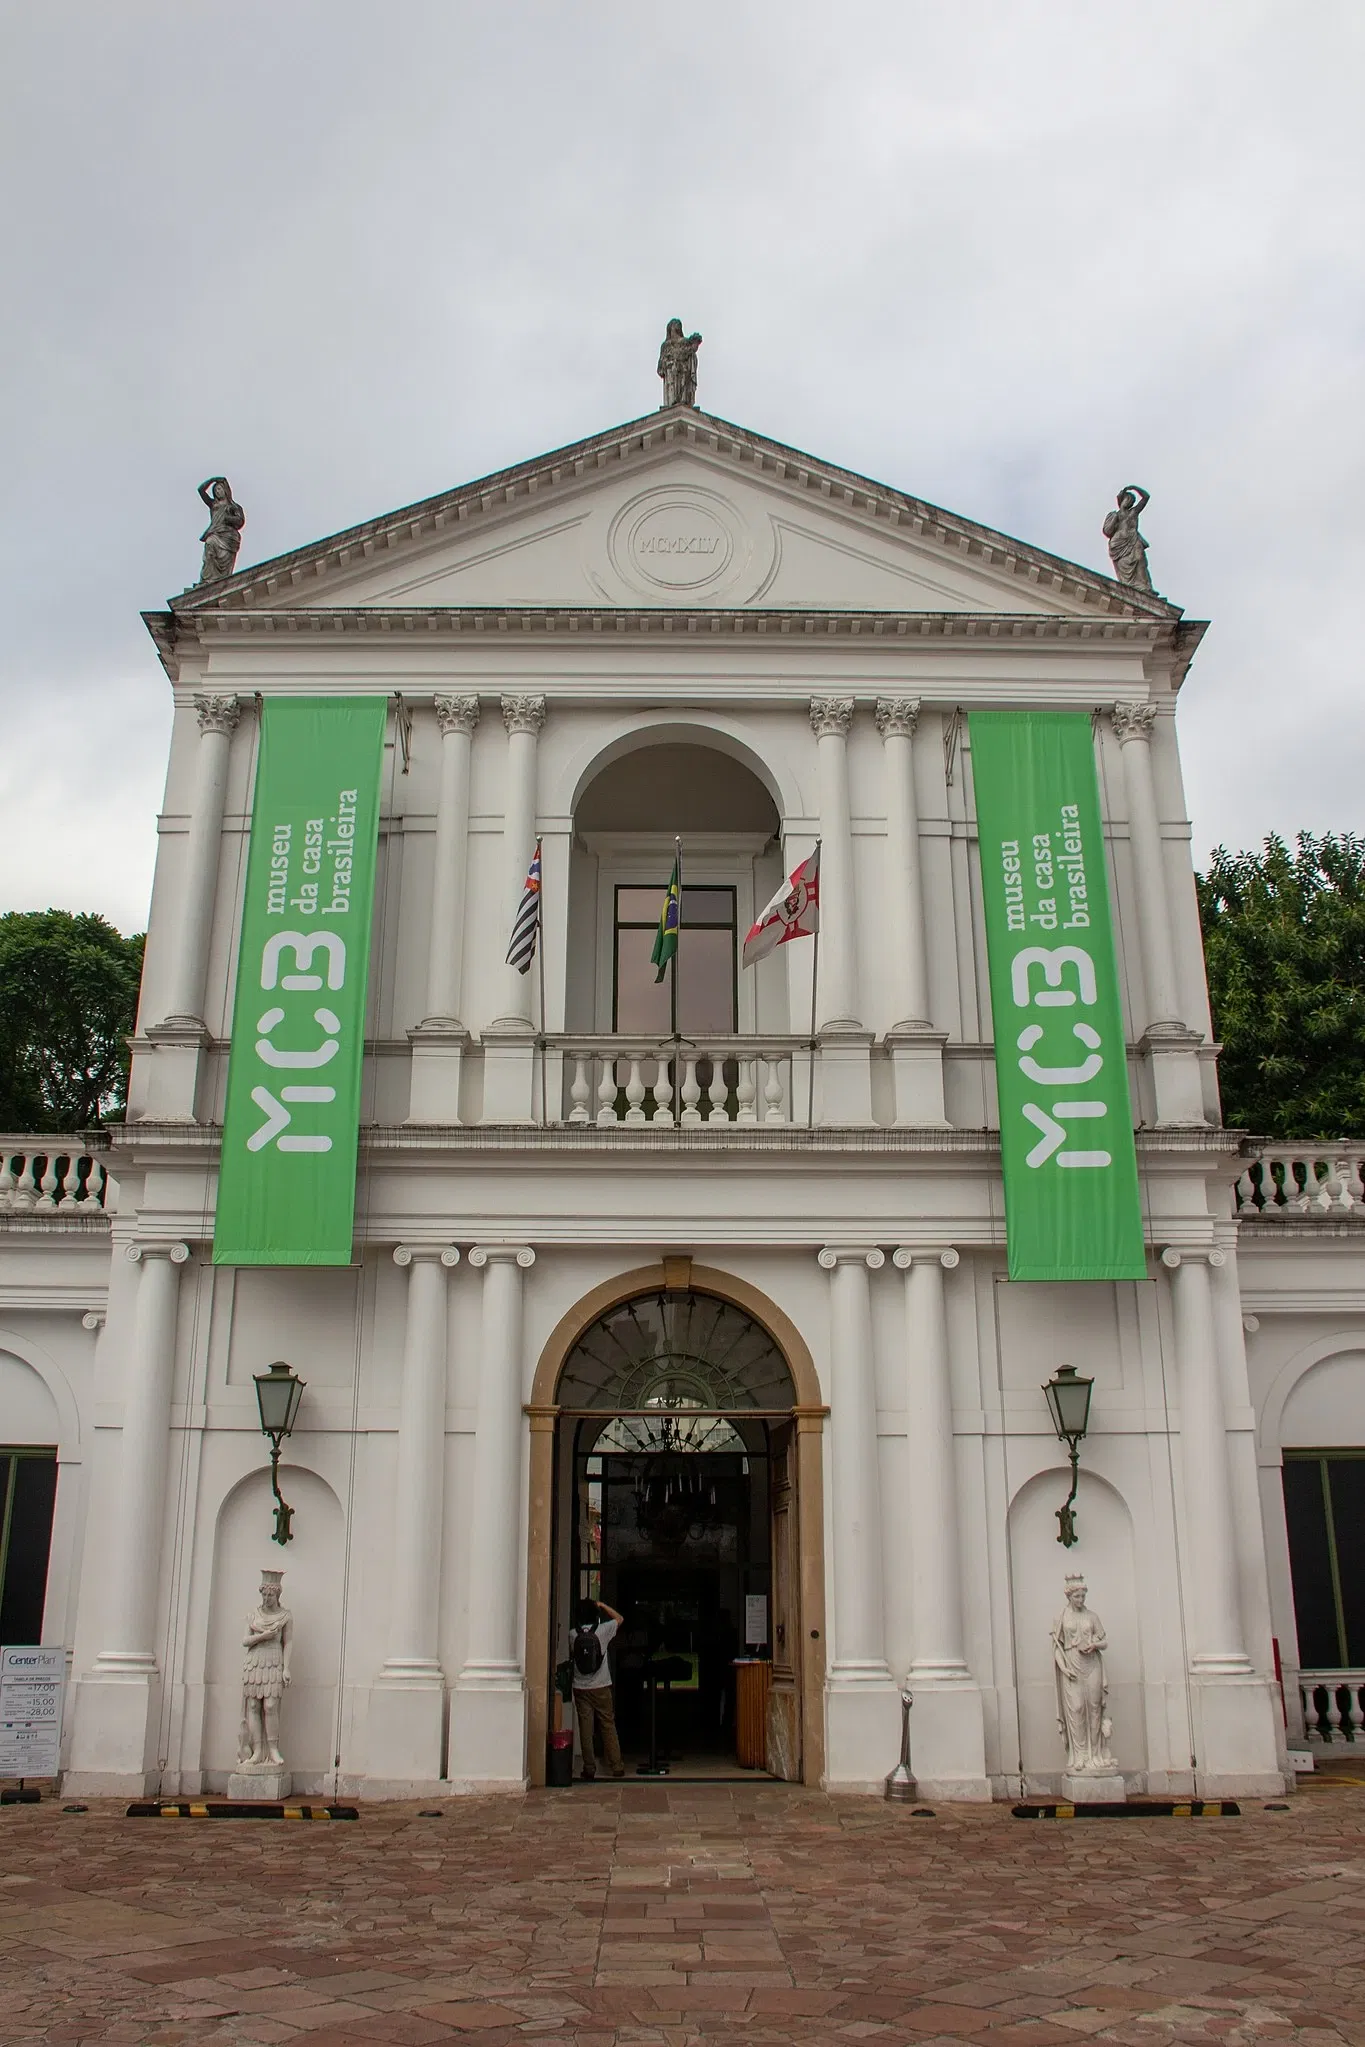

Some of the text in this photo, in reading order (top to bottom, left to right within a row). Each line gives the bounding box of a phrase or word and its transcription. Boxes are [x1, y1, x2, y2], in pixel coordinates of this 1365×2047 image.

[266, 823, 292, 915] museu
[290, 818, 324, 915] da casa
[321, 789, 358, 915] brasileira
[1001, 839, 1026, 932] museu
[1029, 833, 1058, 930] da casa
[1056, 804, 1090, 930] brasileira
[246, 930, 346, 1153] MCB
[1011, 945, 1112, 1169] MCB
